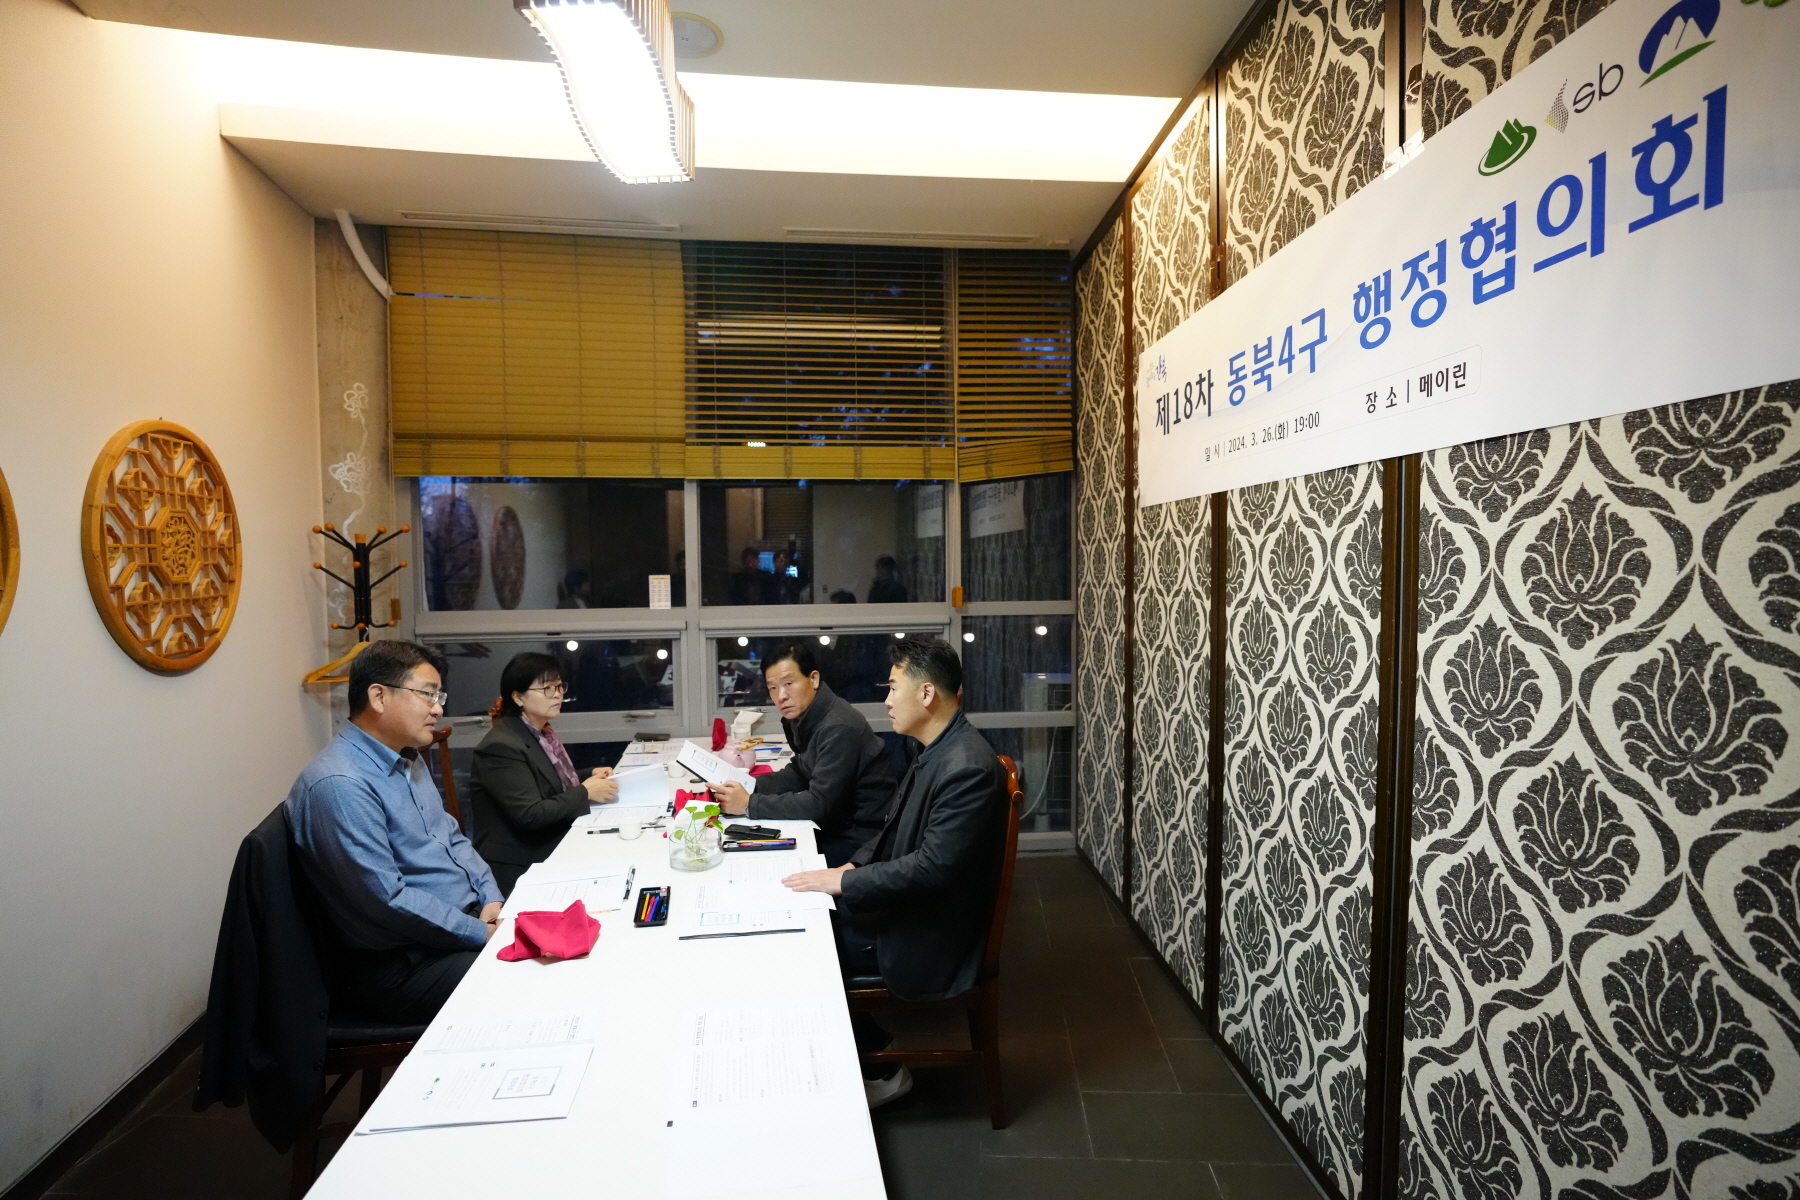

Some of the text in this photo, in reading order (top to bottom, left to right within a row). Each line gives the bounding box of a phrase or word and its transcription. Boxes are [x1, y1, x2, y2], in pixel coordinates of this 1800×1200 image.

[1573, 62, 1624, 113] sb
[1156, 84, 1728, 435] 제18차 동북4구 행정협의회
[1419, 362, 1467, 398] 메이린
[1229, 436, 1248, 453] 2024.
[1294, 411, 1320, 433] 19:00
